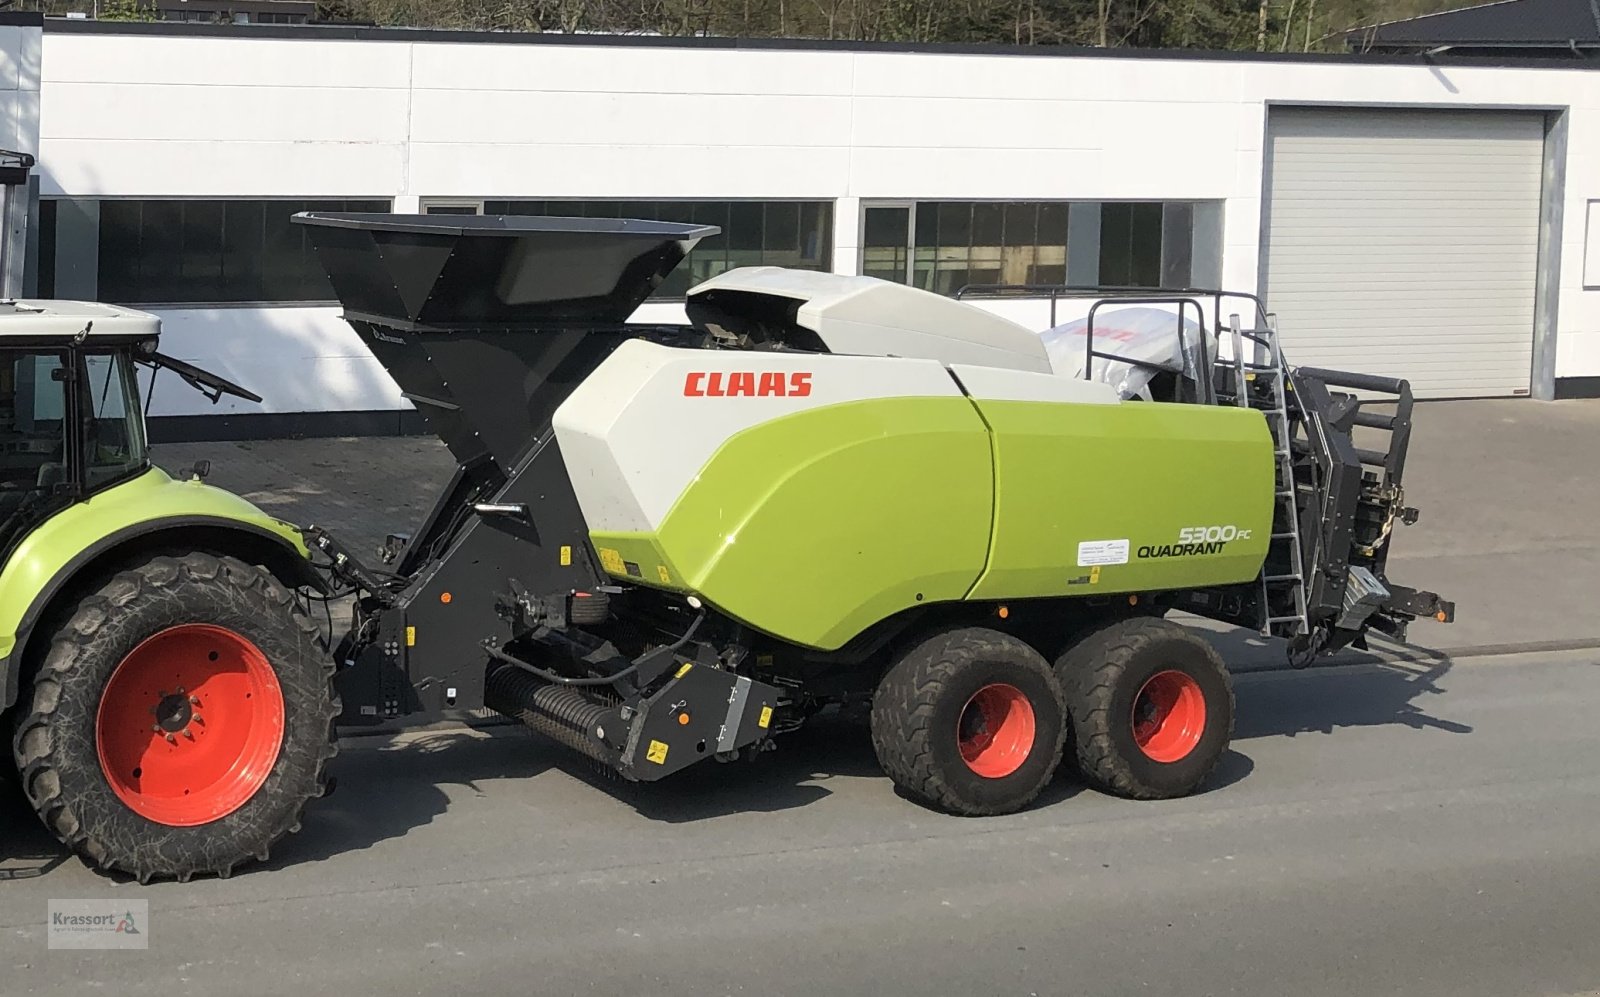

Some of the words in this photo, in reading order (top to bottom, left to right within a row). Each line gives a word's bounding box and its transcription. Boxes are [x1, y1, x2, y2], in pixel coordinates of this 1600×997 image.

[684, 372, 812, 397] CLAAS
[1178, 525, 1236, 544] 5300
[1236, 529, 1252, 541] FC
[1137, 541, 1227, 558] QUADRANT
